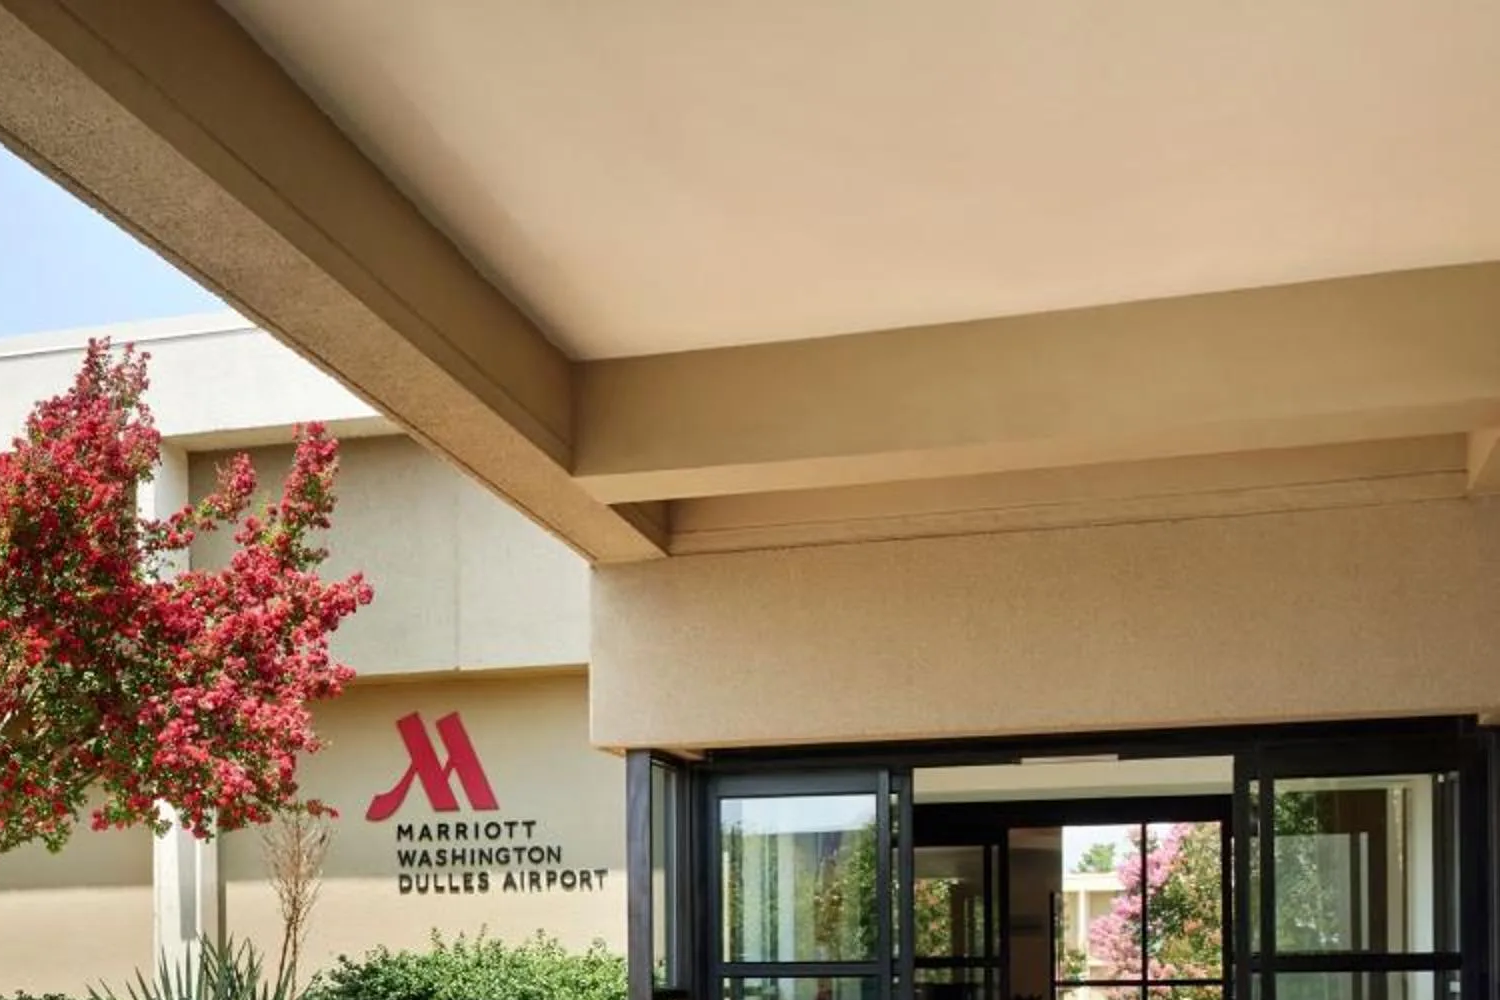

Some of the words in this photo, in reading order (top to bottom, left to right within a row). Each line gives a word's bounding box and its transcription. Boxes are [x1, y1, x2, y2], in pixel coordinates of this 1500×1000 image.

[397, 820, 537, 842] MARRIOTT
[397, 845, 563, 869] WASHINGTON
[398, 871, 490, 895] DULLES
[502, 868, 609, 893] AIRPORT
